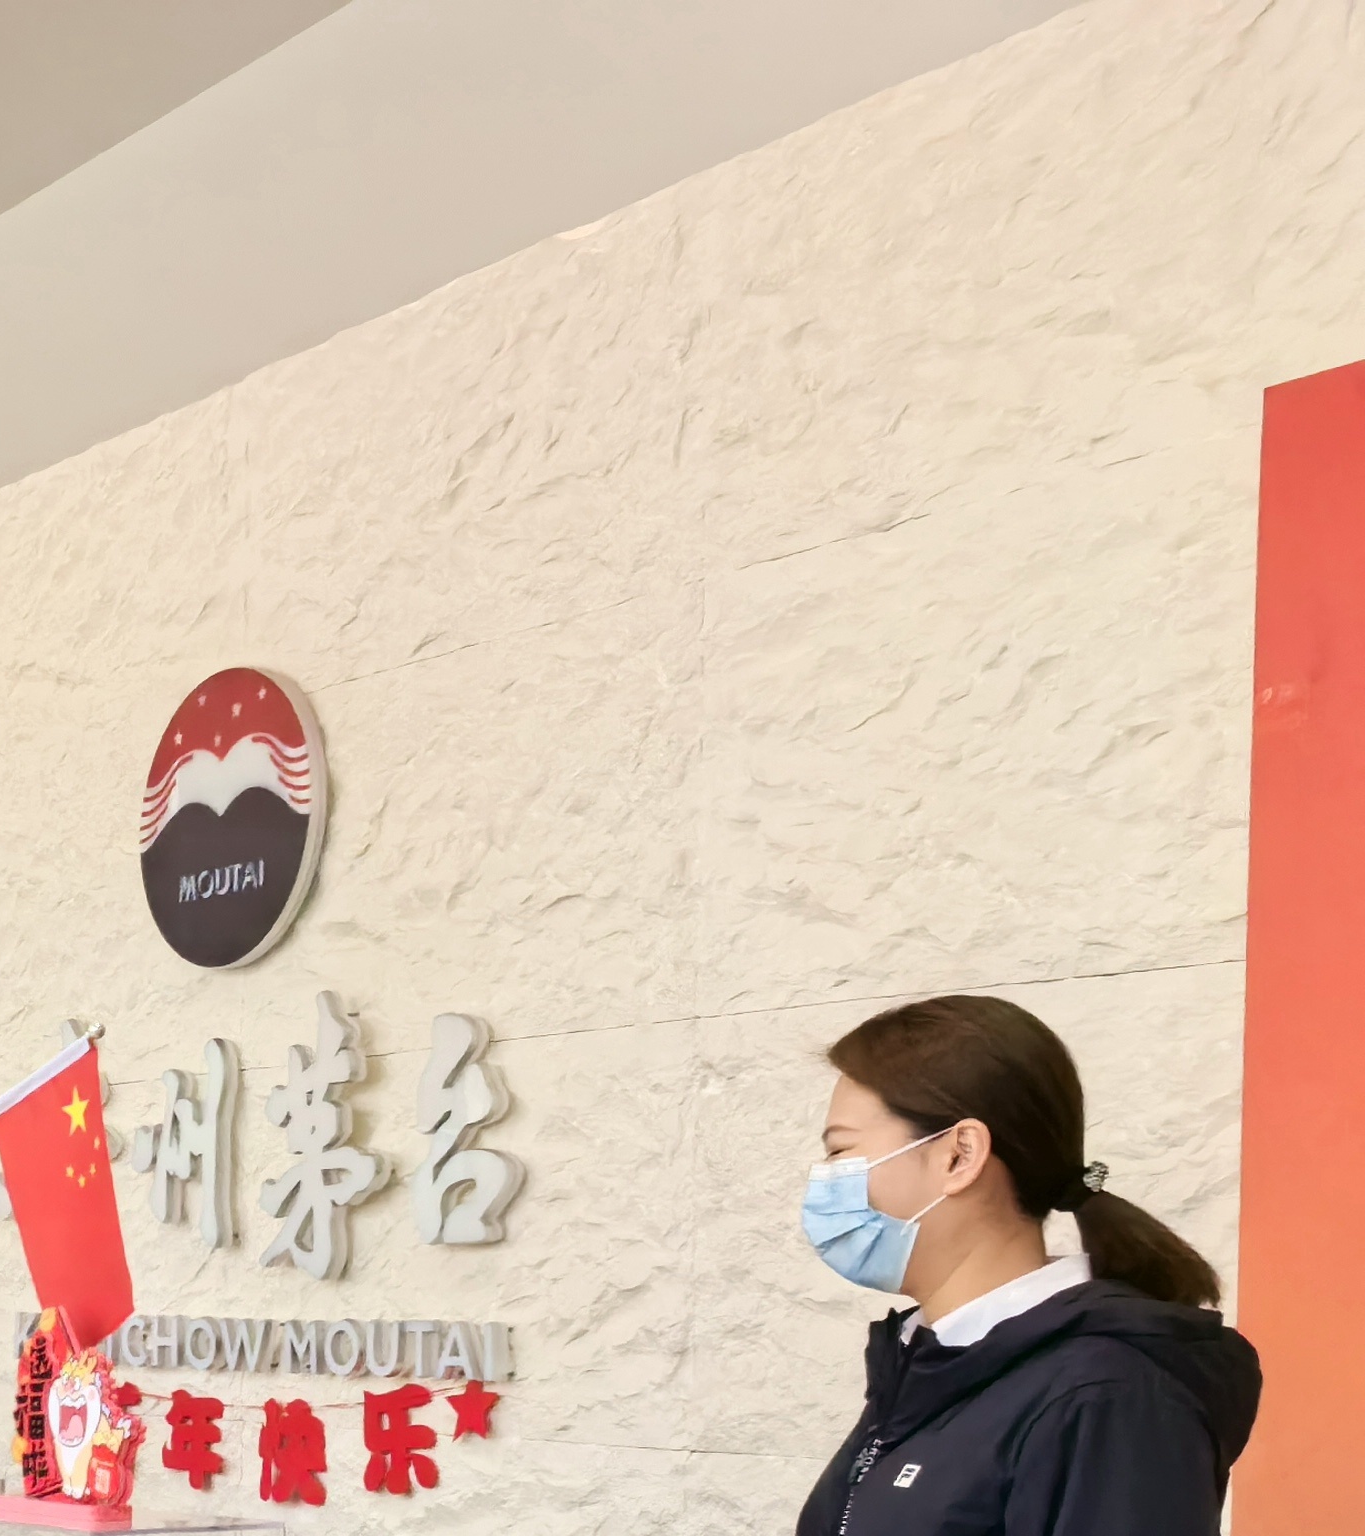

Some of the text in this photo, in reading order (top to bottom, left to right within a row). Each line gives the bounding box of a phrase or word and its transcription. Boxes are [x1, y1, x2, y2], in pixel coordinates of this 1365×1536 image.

[177, 858, 265, 903] MOUTAI
[282, 1319, 509, 1381] MOUTAI
[118, 1382, 440, 1506] 年快乐
